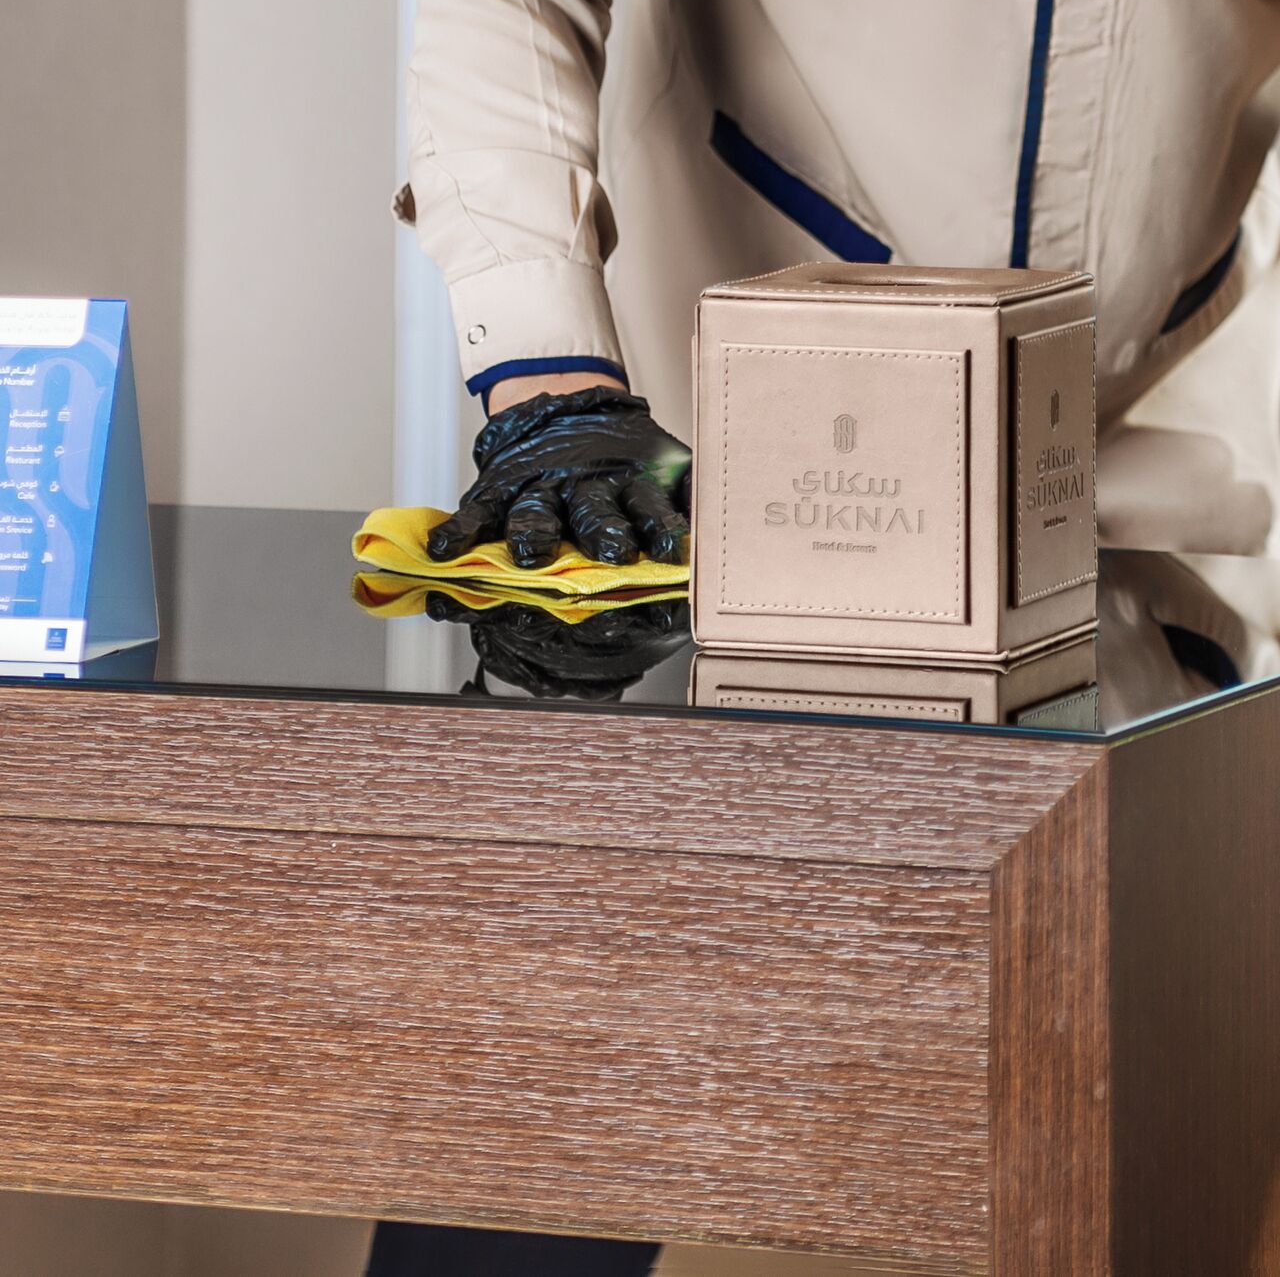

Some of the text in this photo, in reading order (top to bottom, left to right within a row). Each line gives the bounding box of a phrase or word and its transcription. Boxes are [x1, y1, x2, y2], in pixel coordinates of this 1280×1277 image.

[3, 377, 35, 386] Number
[9, 419, 48, 429] Reception
[791, 469, 902, 503] سكناي
[1026, 472, 1085, 511] SUKNAI
[764, 501, 926, 534] SUKNAI
